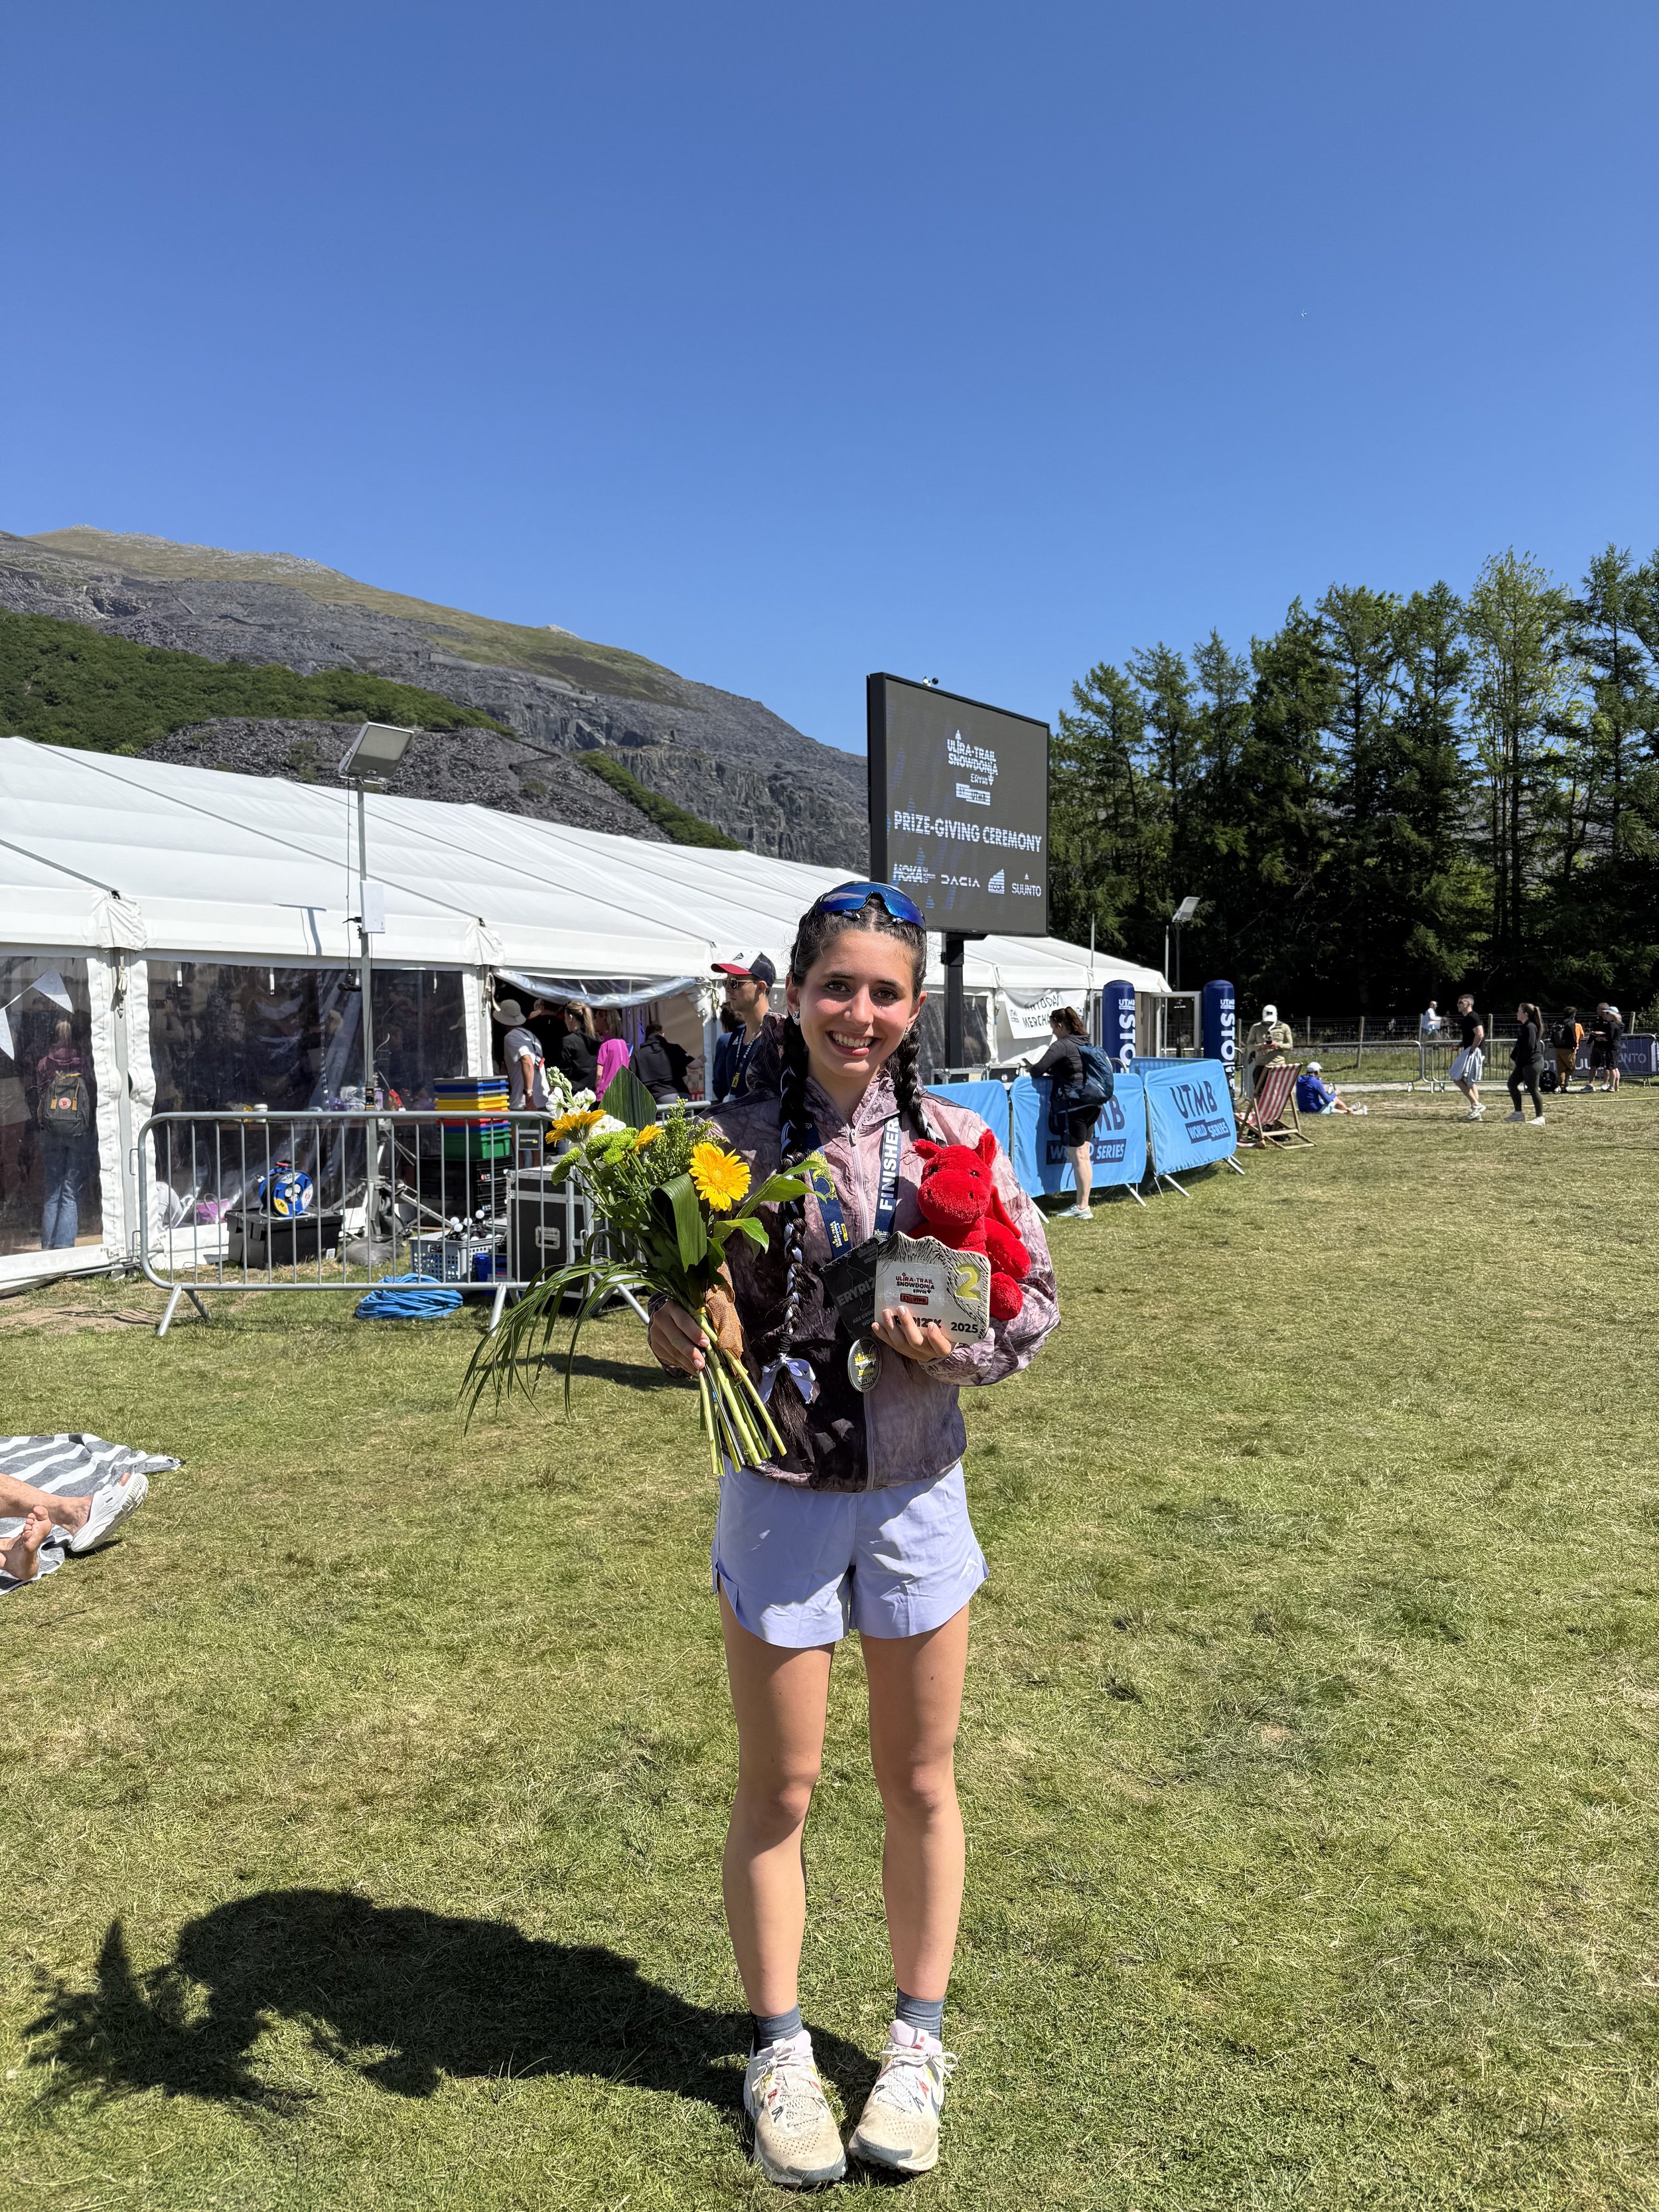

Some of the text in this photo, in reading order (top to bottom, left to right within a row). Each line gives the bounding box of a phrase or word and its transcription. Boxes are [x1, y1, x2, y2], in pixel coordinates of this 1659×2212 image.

[948, 753, 998, 776] SNOWDONIA
[894, 810, 1042, 853] PRIZE-GIVING CEREMONY
[940, 874, 981, 888] DACIA
[1011, 883, 1042, 897] SUUNTO
[1023, 1013, 1050, 1029] MERCHA
[1169, 1080, 1218, 1119] UTMB
[1187, 1122, 1229, 1140] WORLD SERIES
[1096, 1143, 1125, 1160] SERIES
[879, 1116, 899, 1211] FINISHER
[896, 1272, 934, 1285] ULTRA-TRAIL
[897, 1281, 935, 1291] SNOWDONIA
[955, 1266, 980, 1301] 2
[862, 1309, 874, 1321] GROU
[950, 1321, 978, 1333] 2025
